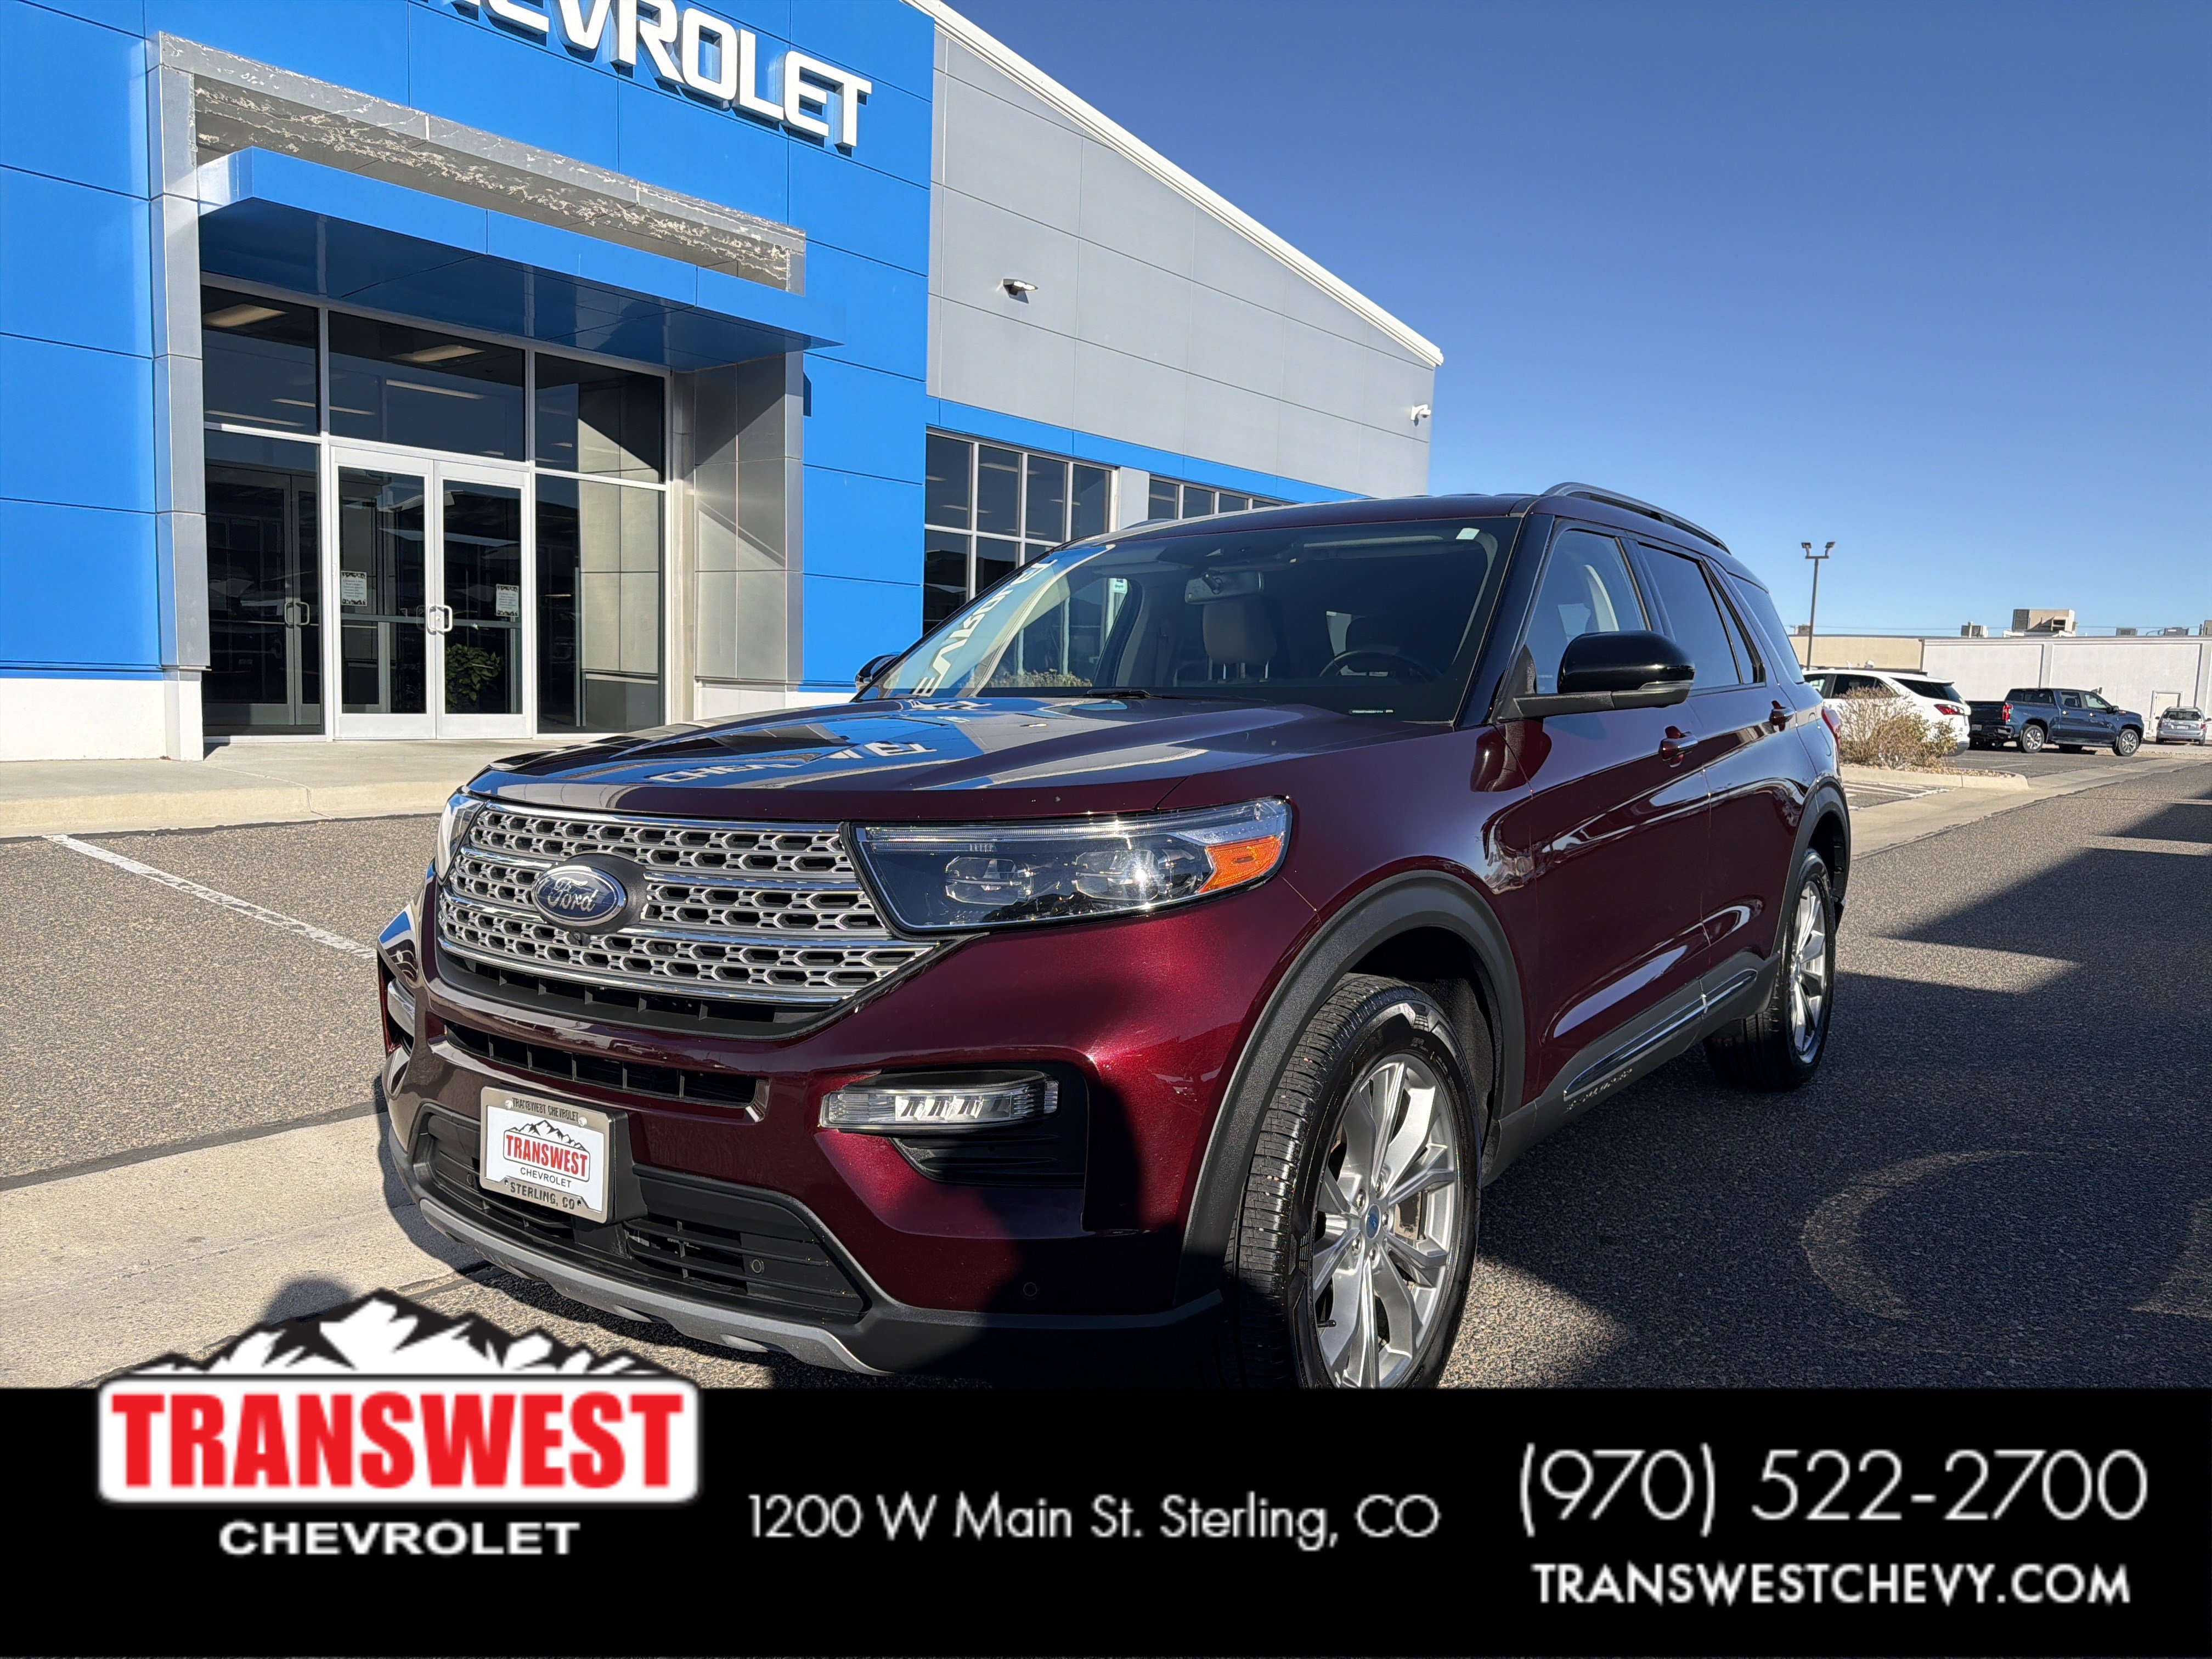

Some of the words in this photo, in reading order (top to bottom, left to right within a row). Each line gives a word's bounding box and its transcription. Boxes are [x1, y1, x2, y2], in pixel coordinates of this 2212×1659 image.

[451, 0, 872, 147] VROLET
[548, 877, 599, 912] Ford
[512, 1097, 546, 1114] TRANSWEST
[548, 1105, 579, 1122] CHEVROLET
[506, 1134, 588, 1177] TRANSWEST
[520, 1167, 572, 1188] CHEVROLET
[510, 1182, 558, 1206] STERLING,
[562, 1197, 575, 1210] CO
